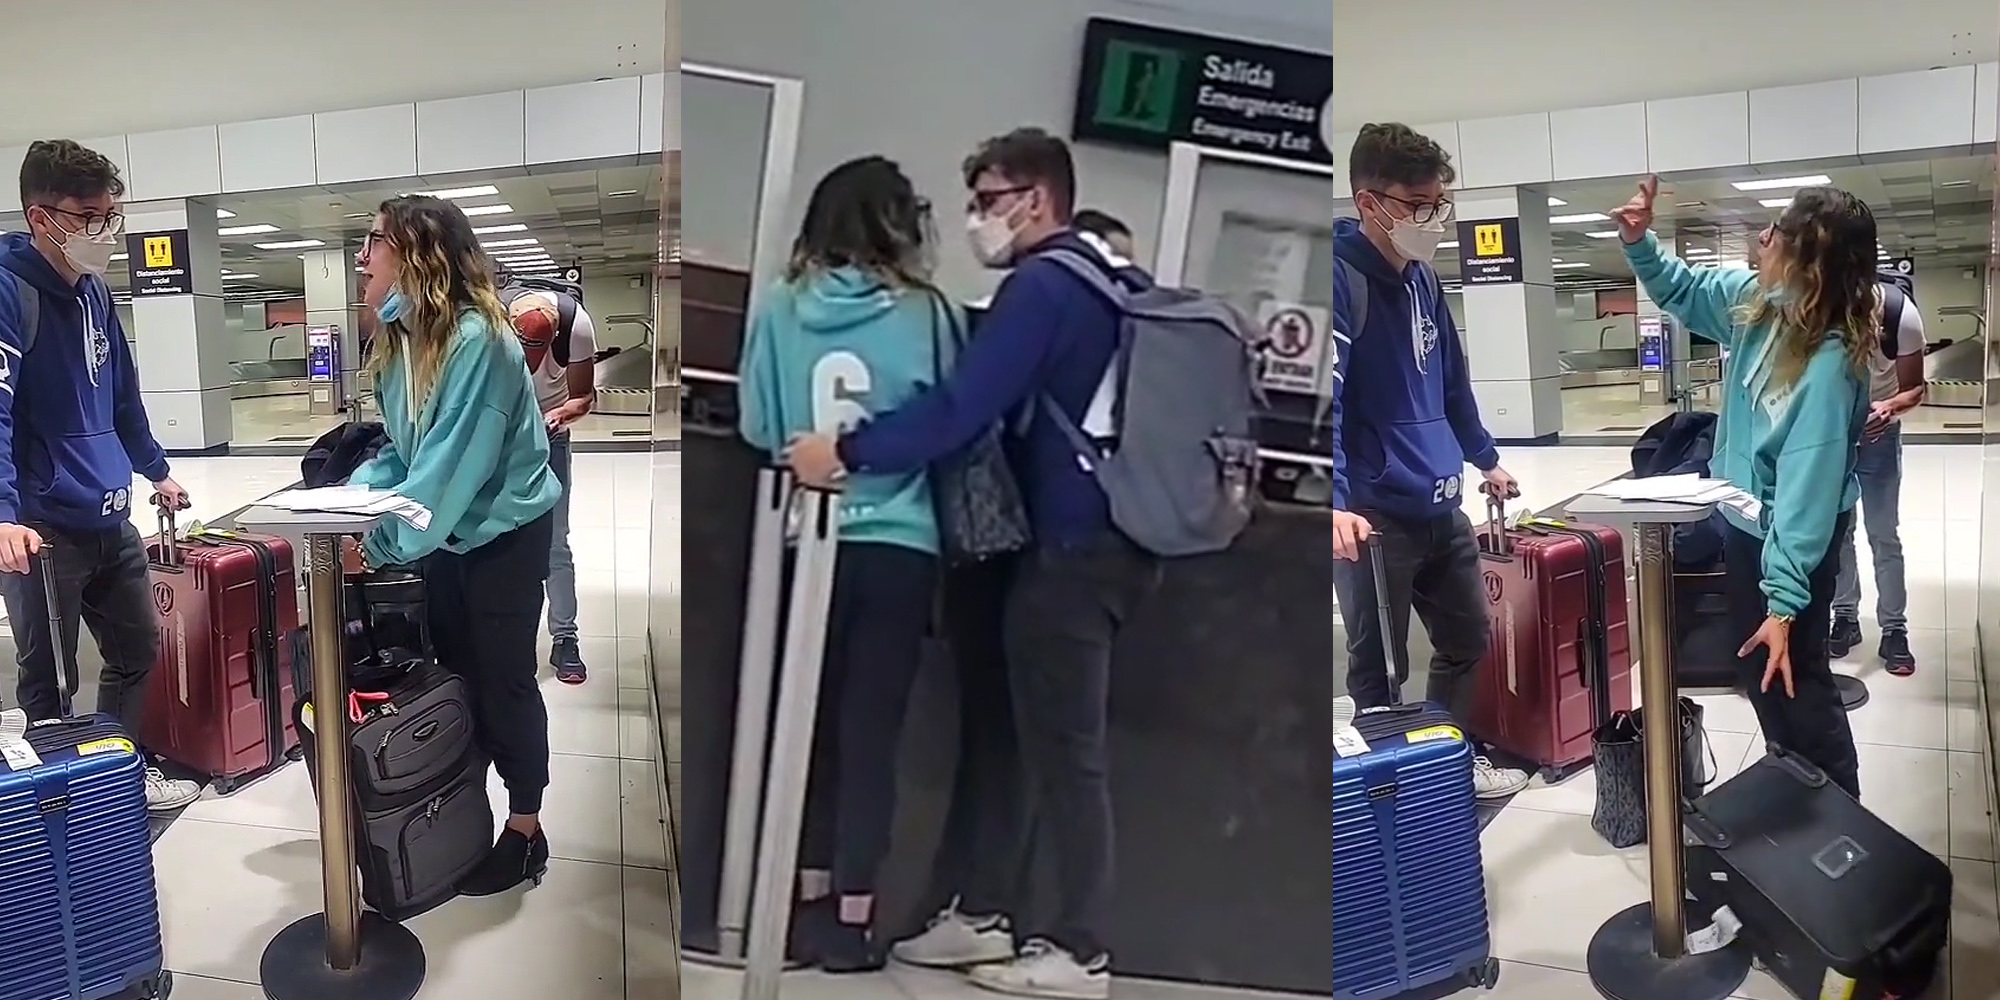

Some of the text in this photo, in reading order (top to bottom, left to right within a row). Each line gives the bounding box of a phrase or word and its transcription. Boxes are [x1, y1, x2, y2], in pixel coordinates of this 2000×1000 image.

[1203, 54, 1274, 89] Salida
[1192, 116, 1311, 151] Emergency Exit
[1466, 256, 1515, 266] Distanciamiento
[135, 268, 185, 278] Distanciamiento
[1482, 265, 1501, 273] social
